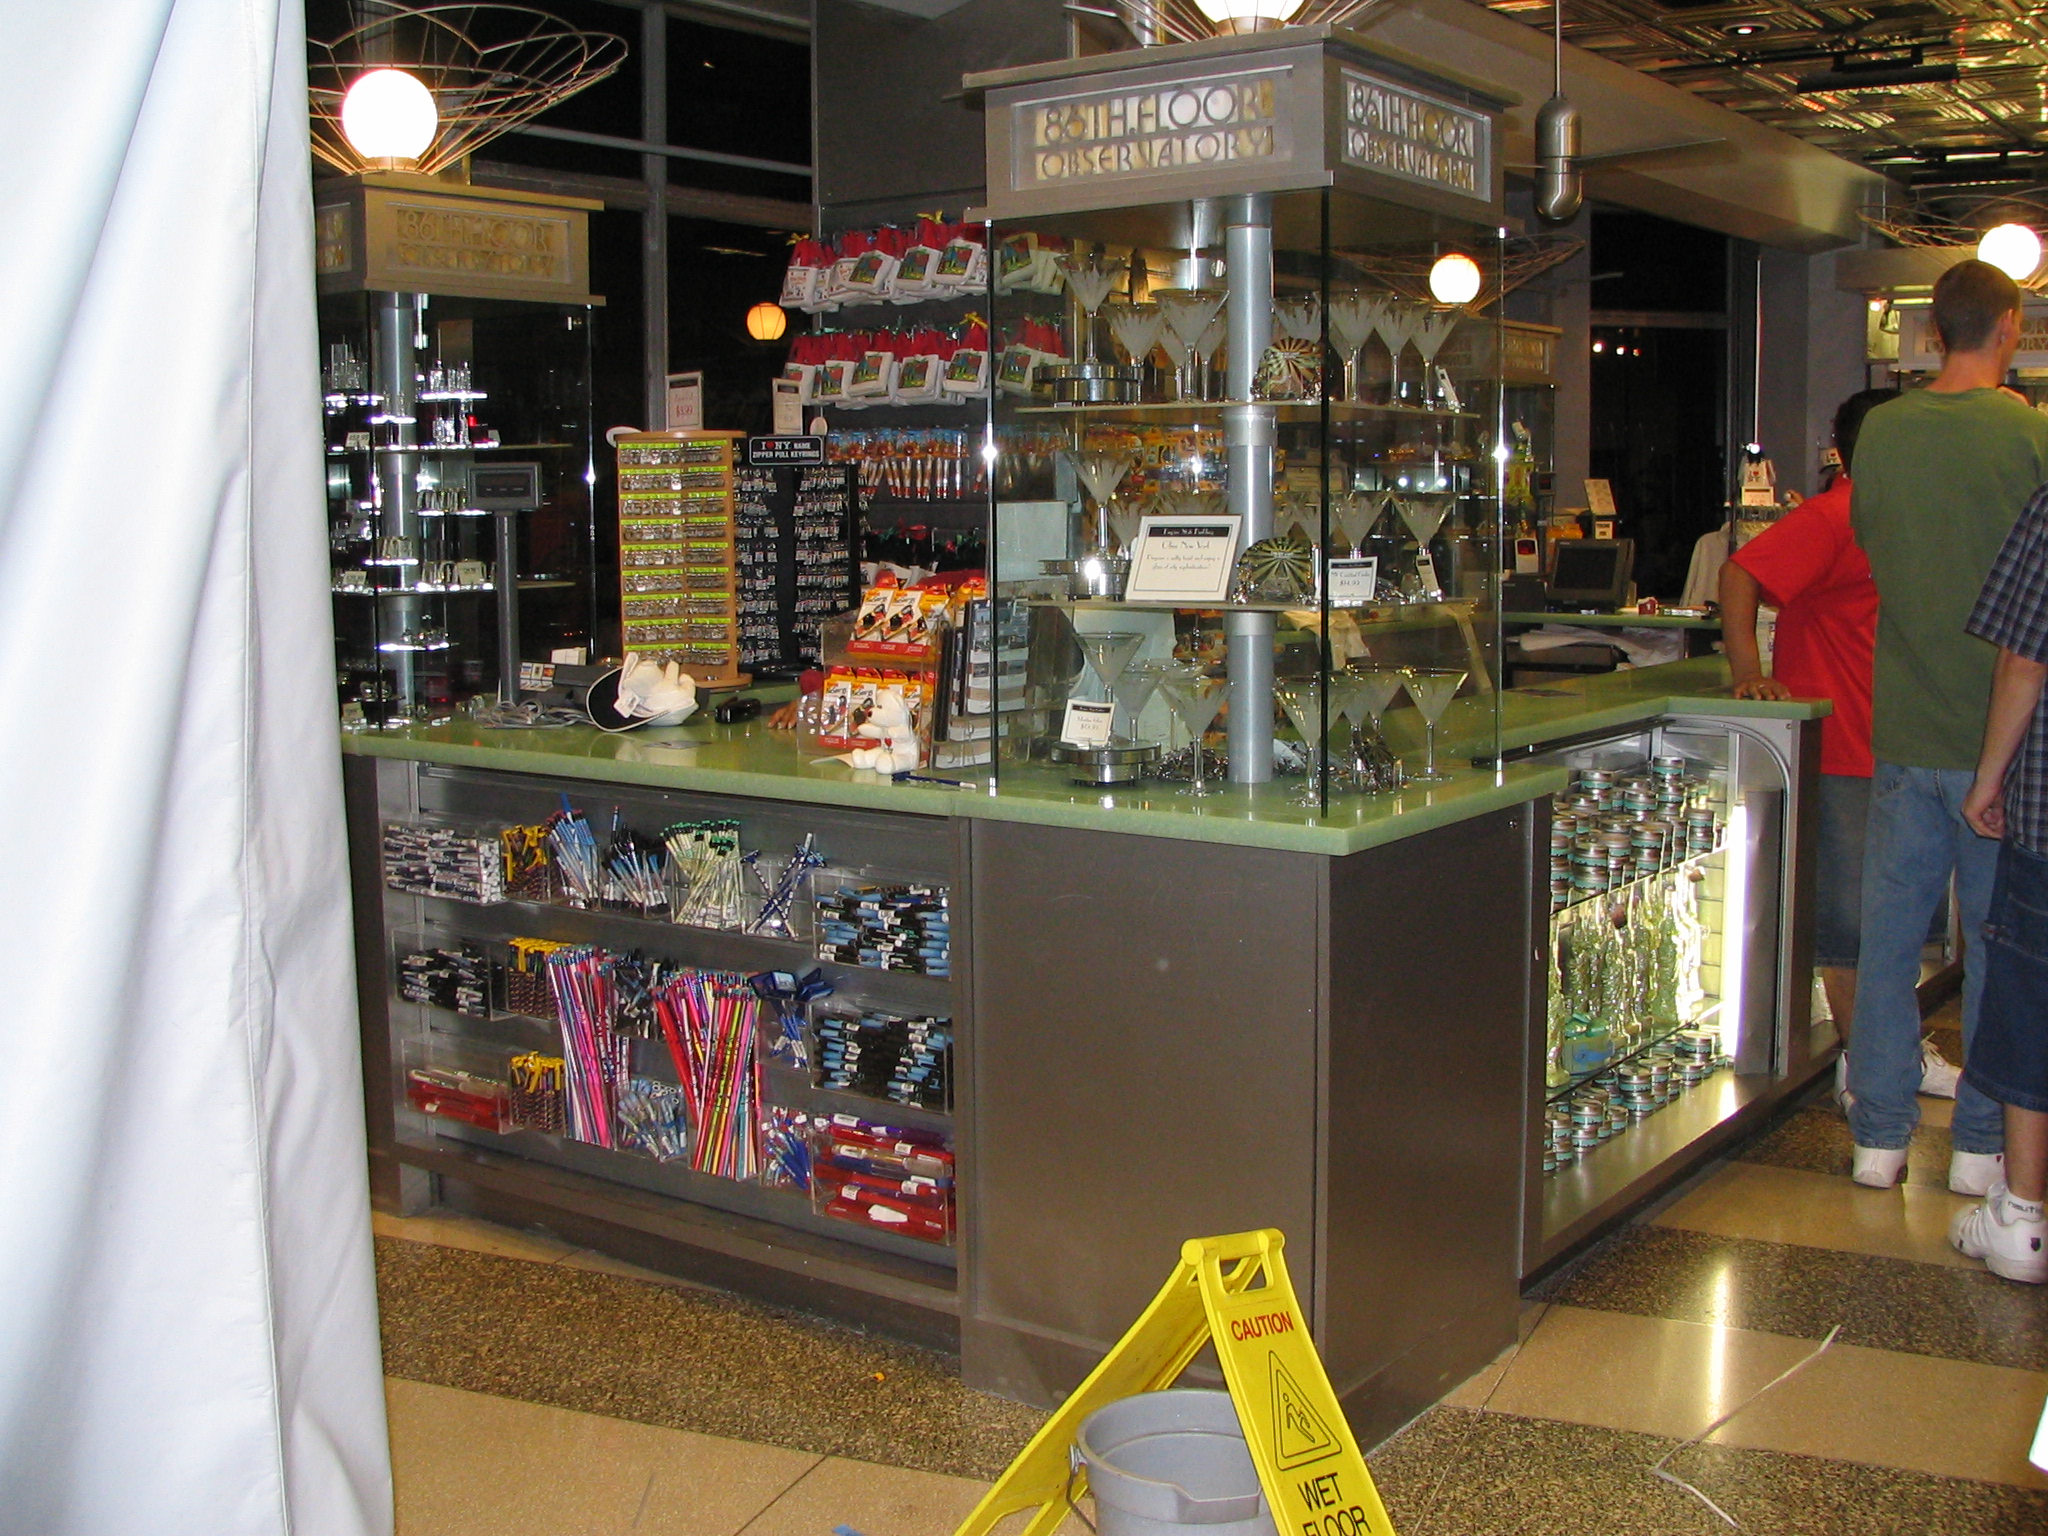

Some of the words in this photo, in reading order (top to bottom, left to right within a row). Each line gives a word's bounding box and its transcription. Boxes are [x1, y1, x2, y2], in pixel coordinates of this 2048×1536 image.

[1042, 124, 1268, 180] OBSERVATORY
[752, 451, 773, 459] ZIPPER
[790, 450, 820, 458] KEYRINGS
[1231, 1311, 1295, 1342] CAUTION
[1297, 1472, 1342, 1512] WET
